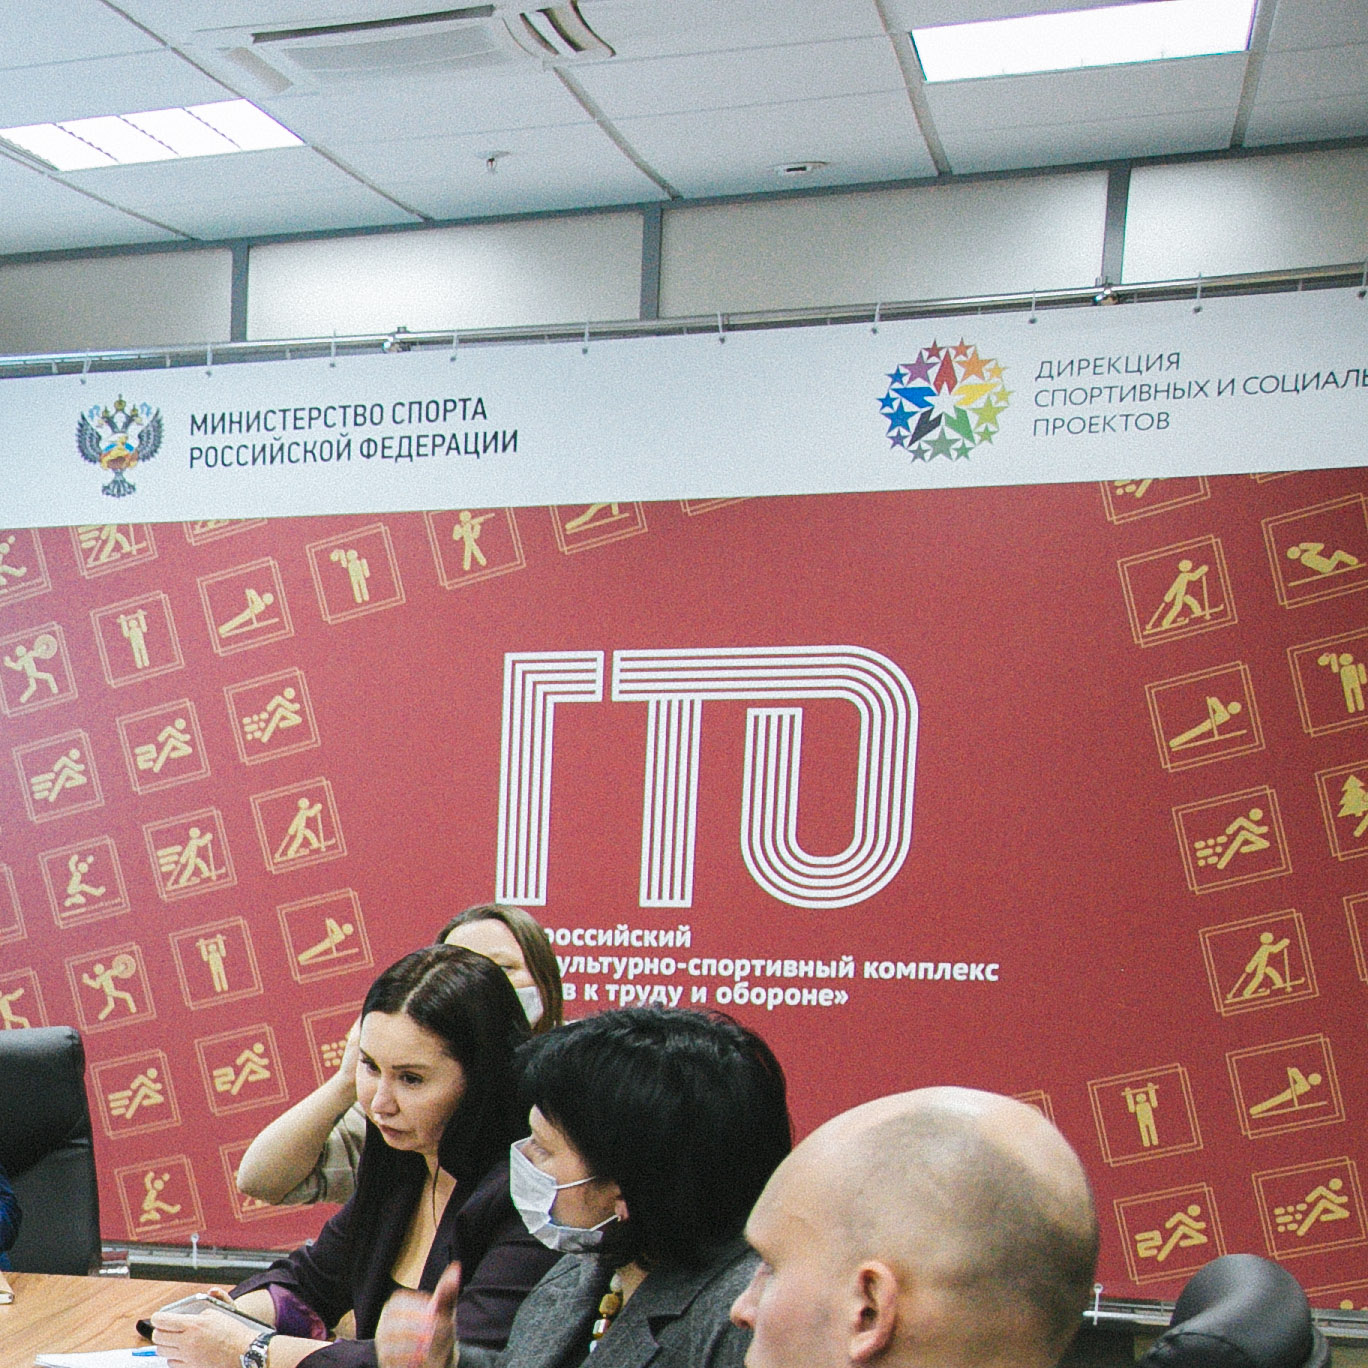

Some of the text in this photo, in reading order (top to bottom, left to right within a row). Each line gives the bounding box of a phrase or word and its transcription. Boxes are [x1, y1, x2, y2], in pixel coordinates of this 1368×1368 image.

[1035, 352, 1180, 381] ДИРЕКЦИЯ
[1035, 380, 1210, 408] СПОРТИВНЫХ
[1216, 378, 1235, 397] И
[190, 397, 487, 436] МИНИСТЕРСТВО СПОРТА
[1033, 412, 1170, 437] ПРОЕКТОВ
[190, 429, 518, 468] РОССИЙСКОЙ ФЕДЕРАЦИИ
[494, 644, 920, 909] ГТО
[555, 955, 1000, 982] ультурно-спортивный комплекс
[584, 983, 599, 1001] к
[605, 983, 683, 1008] труду
[691, 984, 707, 1004] и
[716, 982, 849, 1010] обороне»
